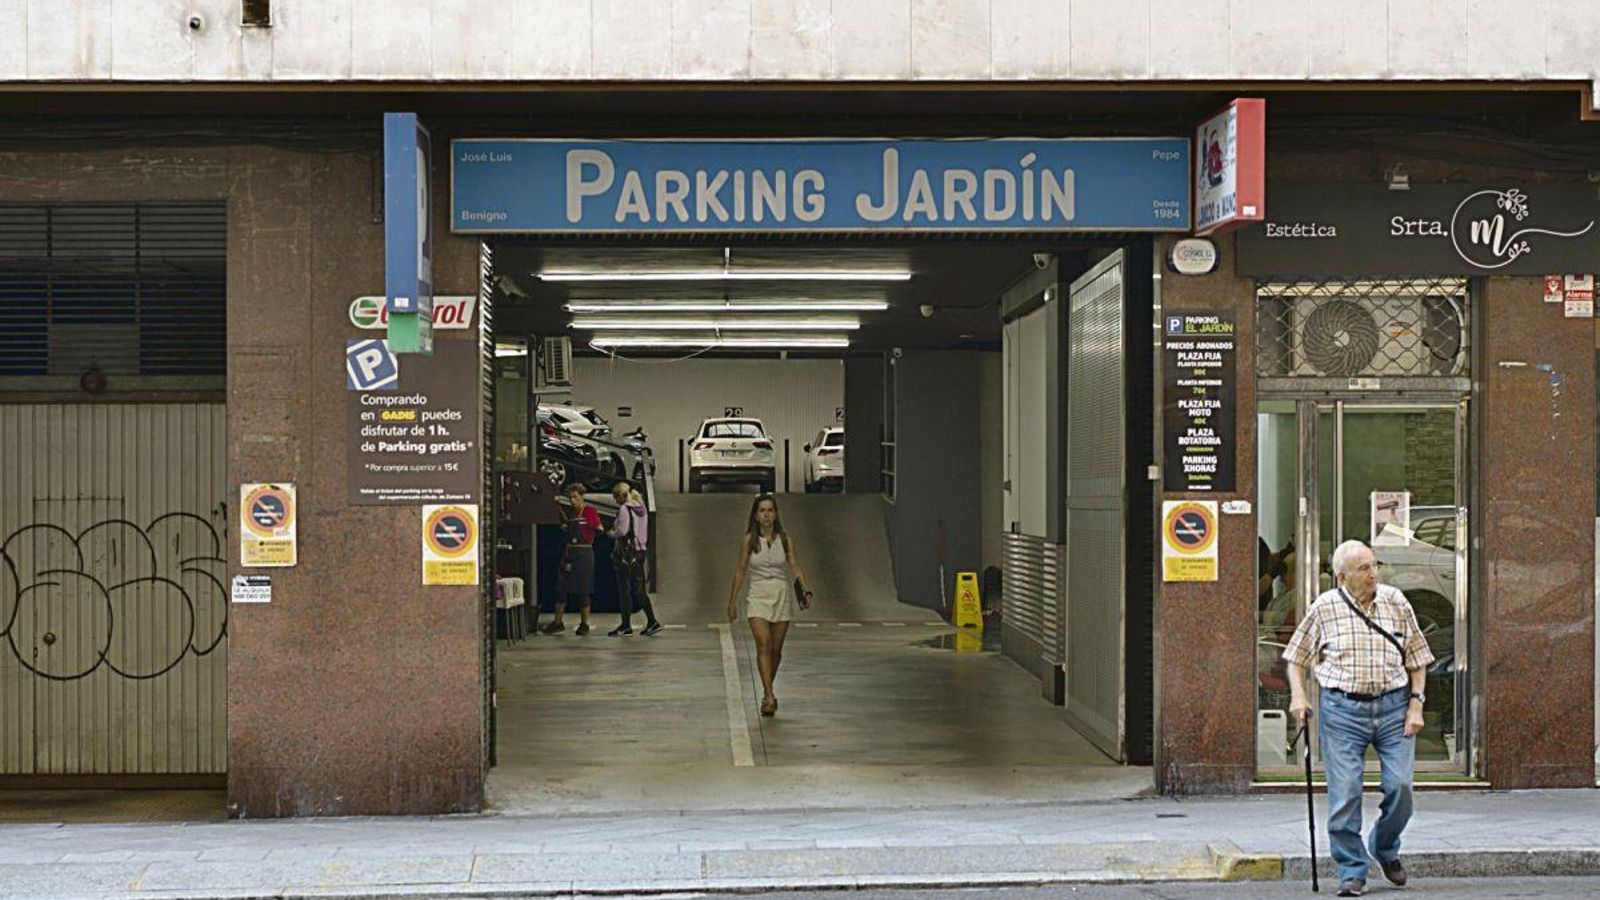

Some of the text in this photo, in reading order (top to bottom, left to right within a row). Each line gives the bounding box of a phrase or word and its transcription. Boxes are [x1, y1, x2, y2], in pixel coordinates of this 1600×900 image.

[461, 151, 513, 163] José Luis
[1152, 149, 1181, 161] Pepe
[566, 147, 1075, 223] PARKING JARDÍN
[1153, 199, 1181, 208] Desde
[461, 210, 508, 222] Benigno
[1153, 208, 1181, 219] 1984
[1265, 222, 1337, 238] Estética
[1390, 216, 1449, 236] Srta.
[1170, 318, 1180, 331] P
[1185, 316, 1219, 324] PARKING
[1185, 321, 1233, 332] EL JARDÍN
[1177, 352, 1222, 360] PLAZA FIJA
[356, 347, 383, 382] P
[360, 392, 428, 407] Comprando
[1177, 400, 1221, 408] PLAZA FIJA
[360, 409, 462, 422] en GADIS puedes
[360, 424, 450, 436] disfrutar de 1 h.
[1188, 428, 1214, 436] PLAZA
[360, 441, 375, 452] de
[378, 440, 426, 454] Parking
[1177, 437, 1221, 445] ROTATORIA
[1182, 456, 1218, 464] PARKING
[383, 464, 408, 472] compra
[410, 463, 436, 472] superior
[444, 463, 458, 471] 15€
